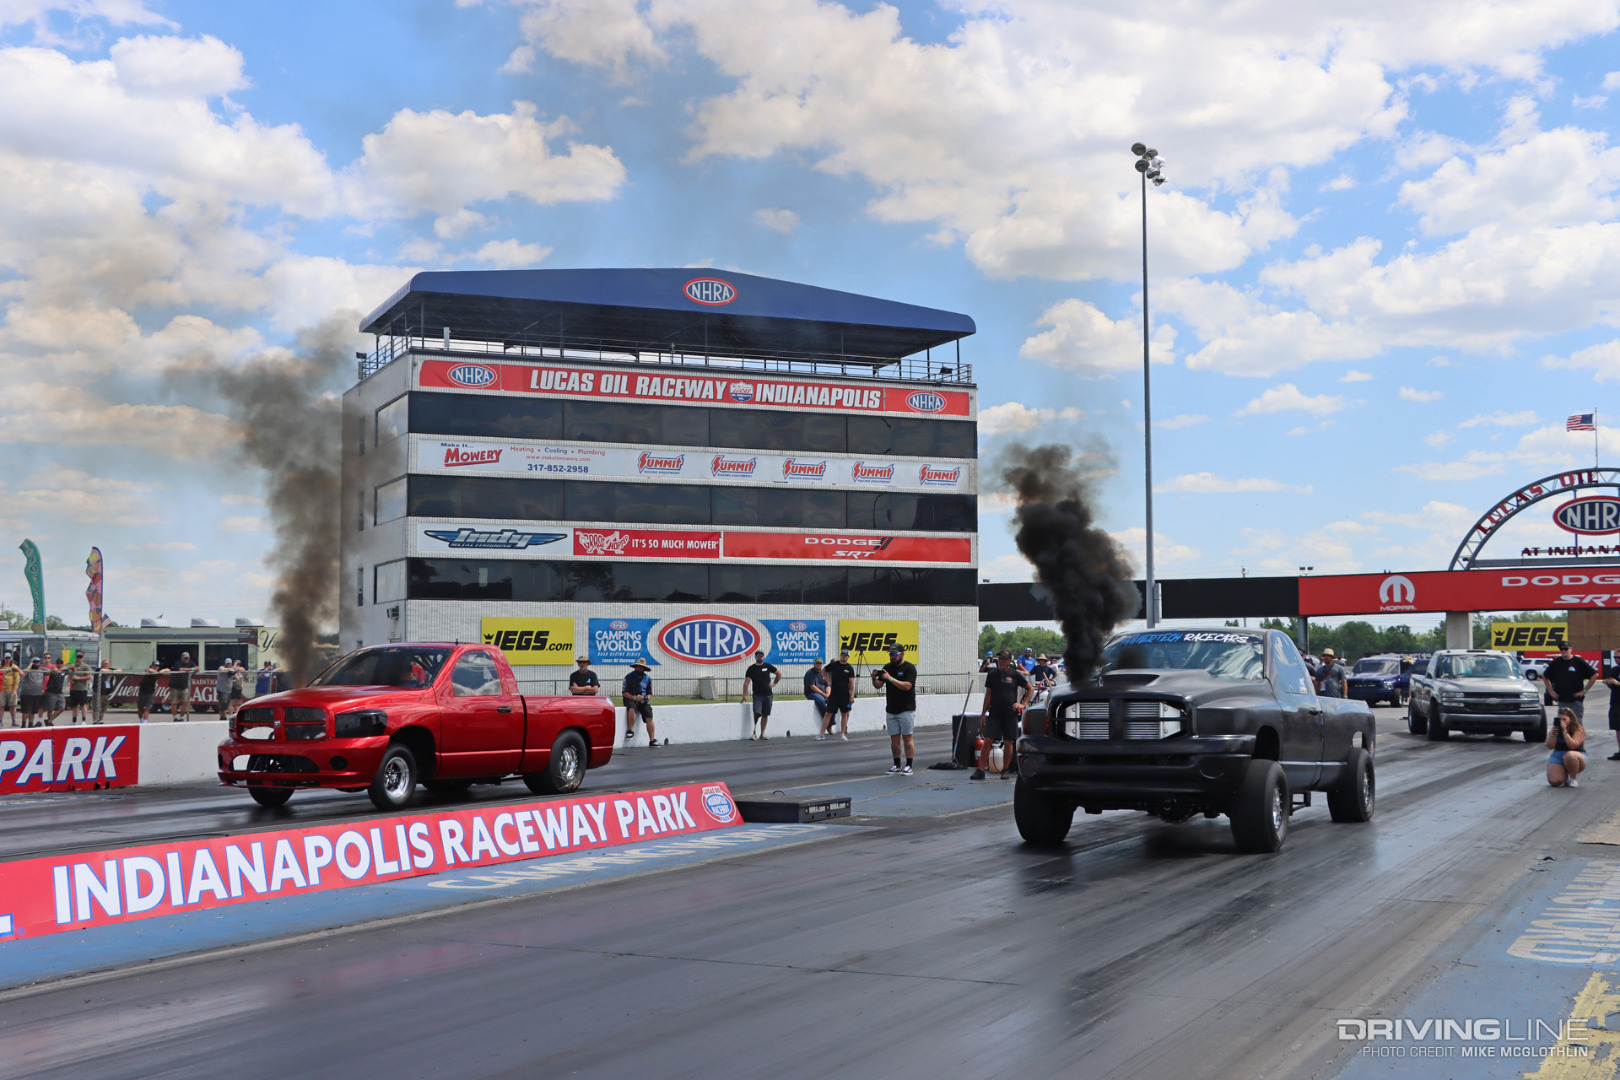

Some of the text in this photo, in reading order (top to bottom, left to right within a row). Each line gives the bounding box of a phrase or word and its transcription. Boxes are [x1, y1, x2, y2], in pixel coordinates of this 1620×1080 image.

[691, 282, 730, 301] NHRA
[455, 367, 490, 384] NHRA
[530, 369, 727, 400] LUCAS OIL RACEWAY
[755, 383, 881, 409] INDIANAPOLIS
[911, 394, 942, 411] NHRA
[444, 447, 502, 465] MOWERY
[510, 446, 606, 457] Heating Cooling Plumbing
[527, 463, 589, 473] 317-852-2958
[1476, 471, 1598, 534] LUCAS OIL
[1566, 502, 1620, 529] NHR
[452, 530, 533, 547] Indy
[632, 539, 717, 549] IT'S SO MUCH MOWER
[804, 537, 881, 545] DODGE
[832, 550, 875, 559] SRT
[1521, 547, 1540, 556] AT
[595, 631, 641, 640] CAMPING
[674, 622, 746, 657] NHRA
[776, 631, 819, 640] CAMPING
[841, 633, 917, 651] JEGSom
[1183, 633, 1249, 644] RACECARS
[1494, 627, 1565, 646] JEGS
[595, 640, 642, 651] WORLD
[776, 640, 819, 651] WORLD
[0, 735, 127, 786] PARK
[53, 791, 697, 926] INDIANAPOLIS RACEWAY PARK
[427, 824, 828, 889] CAMPING WORLD
